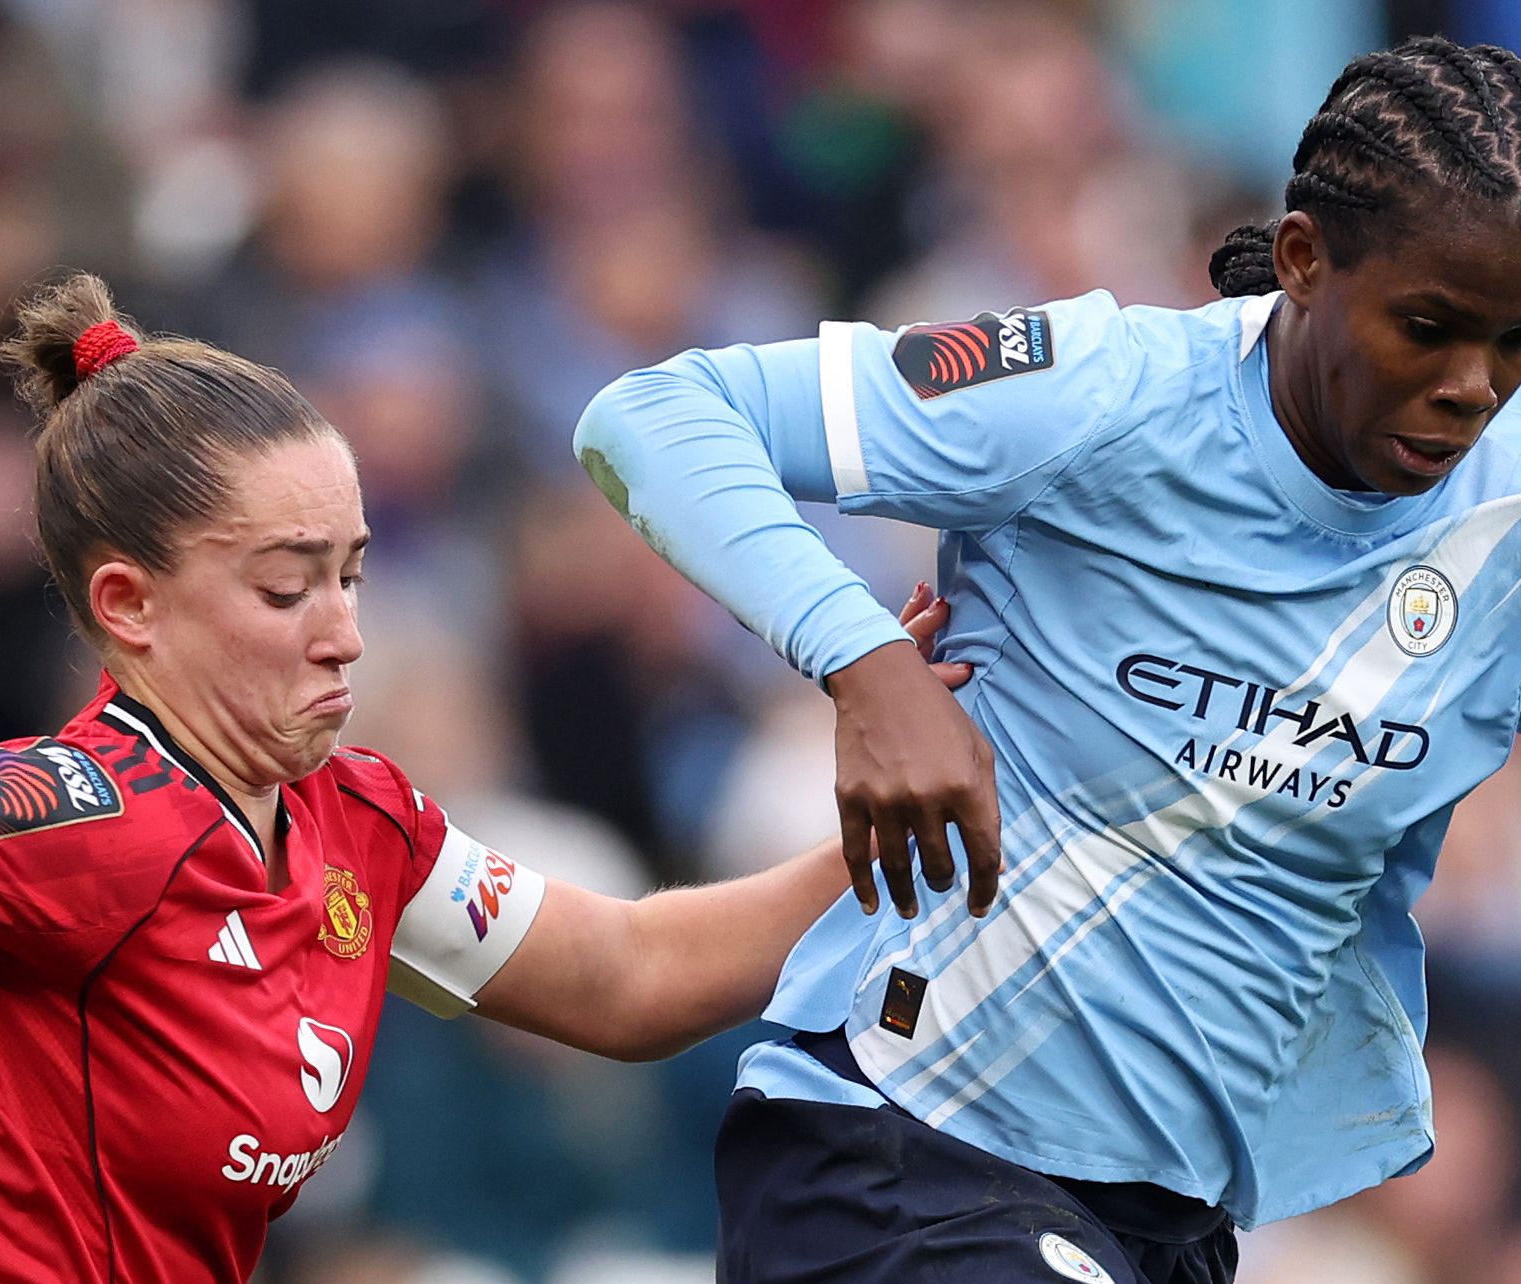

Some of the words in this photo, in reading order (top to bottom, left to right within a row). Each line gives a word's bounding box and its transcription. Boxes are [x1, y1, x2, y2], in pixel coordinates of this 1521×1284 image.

[999, 313, 1030, 370] WSL
[1029, 321, 1045, 363] BARCLAYS
[1395, 573, 1450, 602] MANCHESTER
[1407, 641, 1428, 651] CITY
[1115, 653, 1430, 771] ETIHAD
[35, 746, 100, 812] WSL
[80, 760, 113, 806] BARCLAYS
[1174, 738, 1353, 808] AIRWAYS
[338, 925, 369, 954] UNITED
